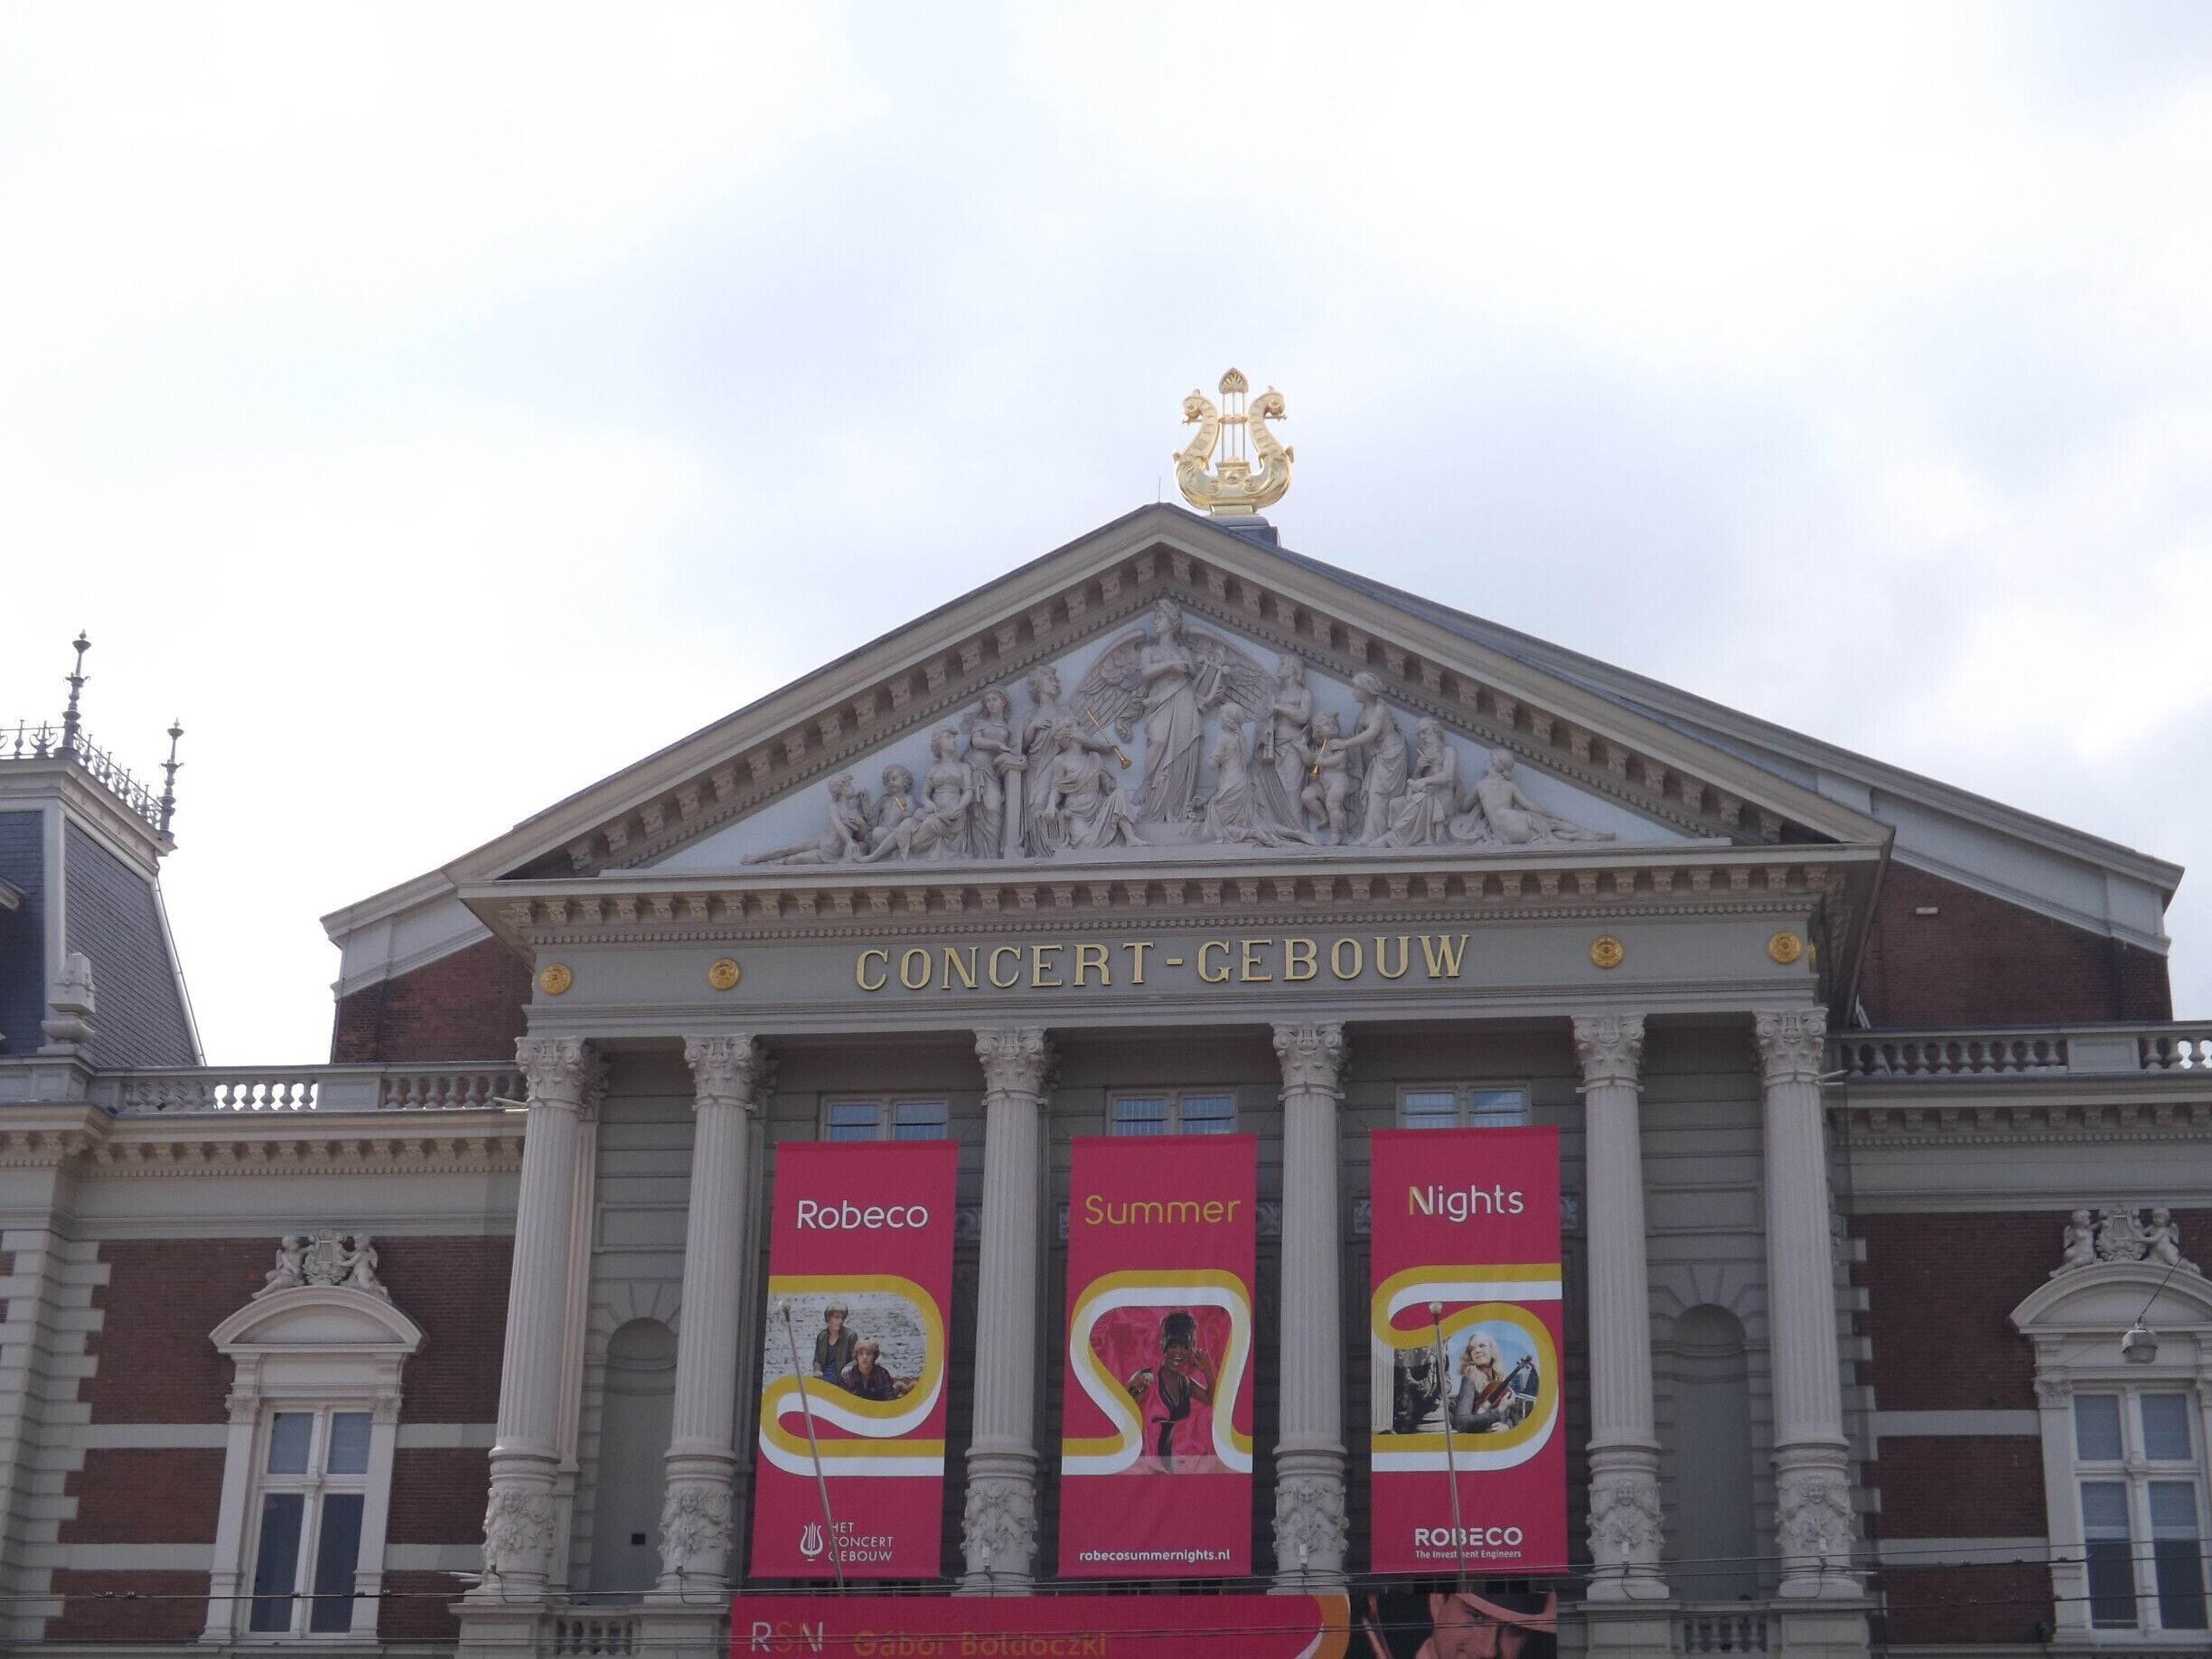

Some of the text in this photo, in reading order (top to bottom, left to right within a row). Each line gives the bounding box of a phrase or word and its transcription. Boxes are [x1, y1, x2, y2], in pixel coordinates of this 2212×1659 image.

[855, 933, 1471, 992] CONCERT-GEBOUW
[796, 1198, 929, 1231] Robeco
[1084, 1195, 1242, 1227] Summer
[1408, 1184, 1525, 1222] Nights
[1414, 1526, 1523, 1547] ROBECO
[1079, 1548, 1232, 1563] robecosummernights.nl
[1415, 1549, 1522, 1560] The Investent Engineers
[750, 1620, 1108, 1656] RSN Gábor Boldoczki
